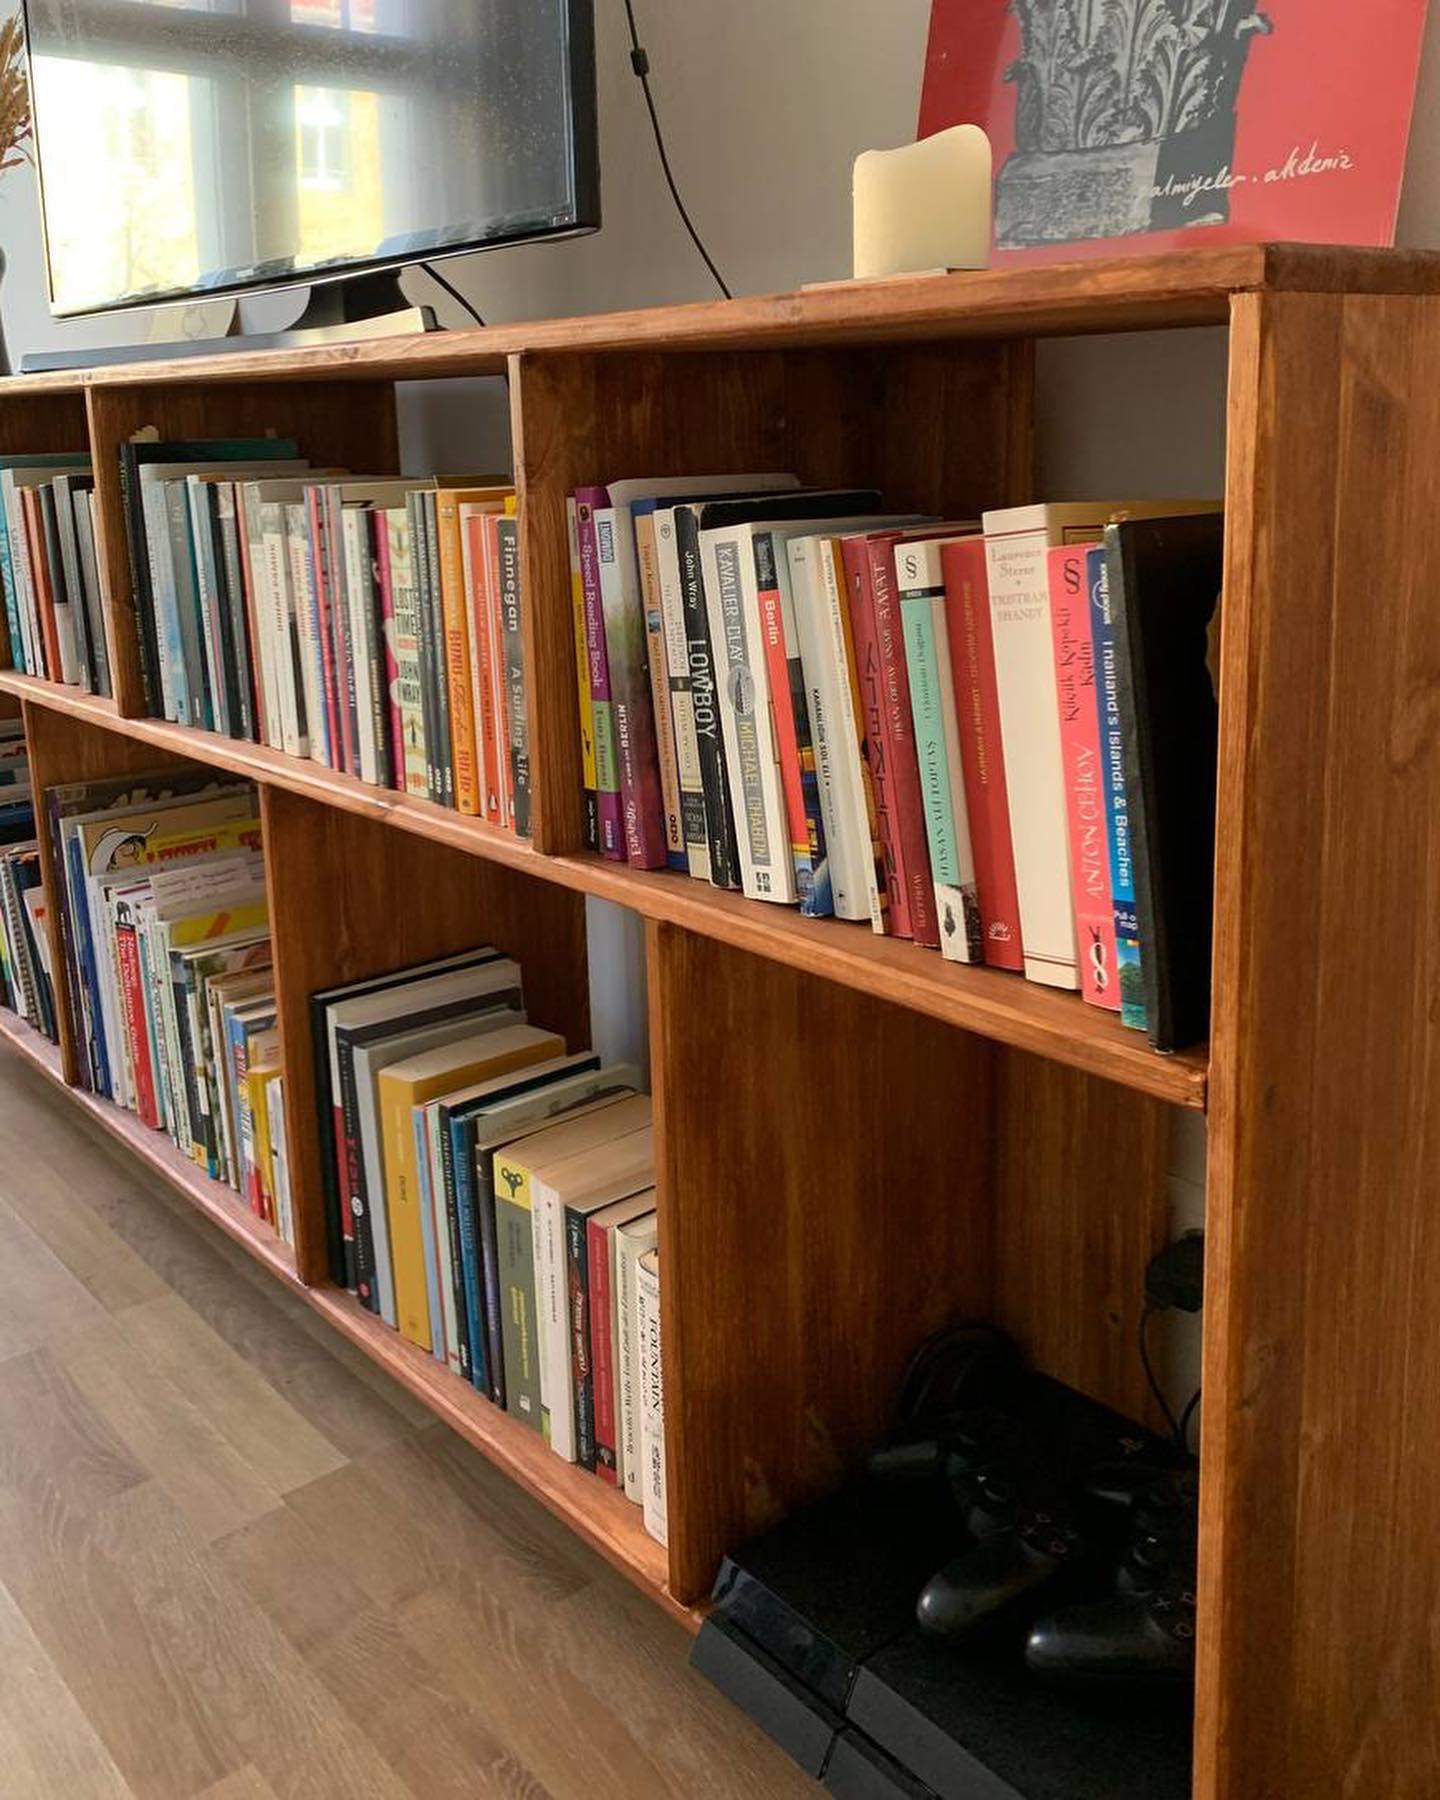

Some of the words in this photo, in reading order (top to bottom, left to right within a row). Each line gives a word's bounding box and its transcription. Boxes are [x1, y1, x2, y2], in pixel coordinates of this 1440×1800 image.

[1265, 141, 1353, 184] akdeniz
[503, 536, 519, 632] Finnegan
[581, 545, 598, 588] Speed
[684, 551, 697, 579] John
[716, 547, 742, 616] KAVALIER
[687, 582, 700, 611] Wray
[585, 591, 602, 649] Reading
[764, 601, 781, 646] Berlin
[724, 626, 745, 662] CLAY
[1077, 641, 1095, 687] Kadın
[511, 666, 521, 679] A
[591, 651, 606, 690] Book
[688, 639, 717, 740] LOWBOY
[512, 685, 526, 748] Surfing
[617, 704, 630, 748] BERLIN
[516, 754, 529, 786] Life
[1108, 731, 1126, 791] Islands
[1114, 796, 1126, 809] &
[934, 827, 951, 878] HASAN
[1080, 823, 1104, 898] ANTON
[1115, 815, 1132, 888] Beaches
[122, 962, 136, 1023] Definitive
[649, 1318, 662, 1412] FOUNTAIN
